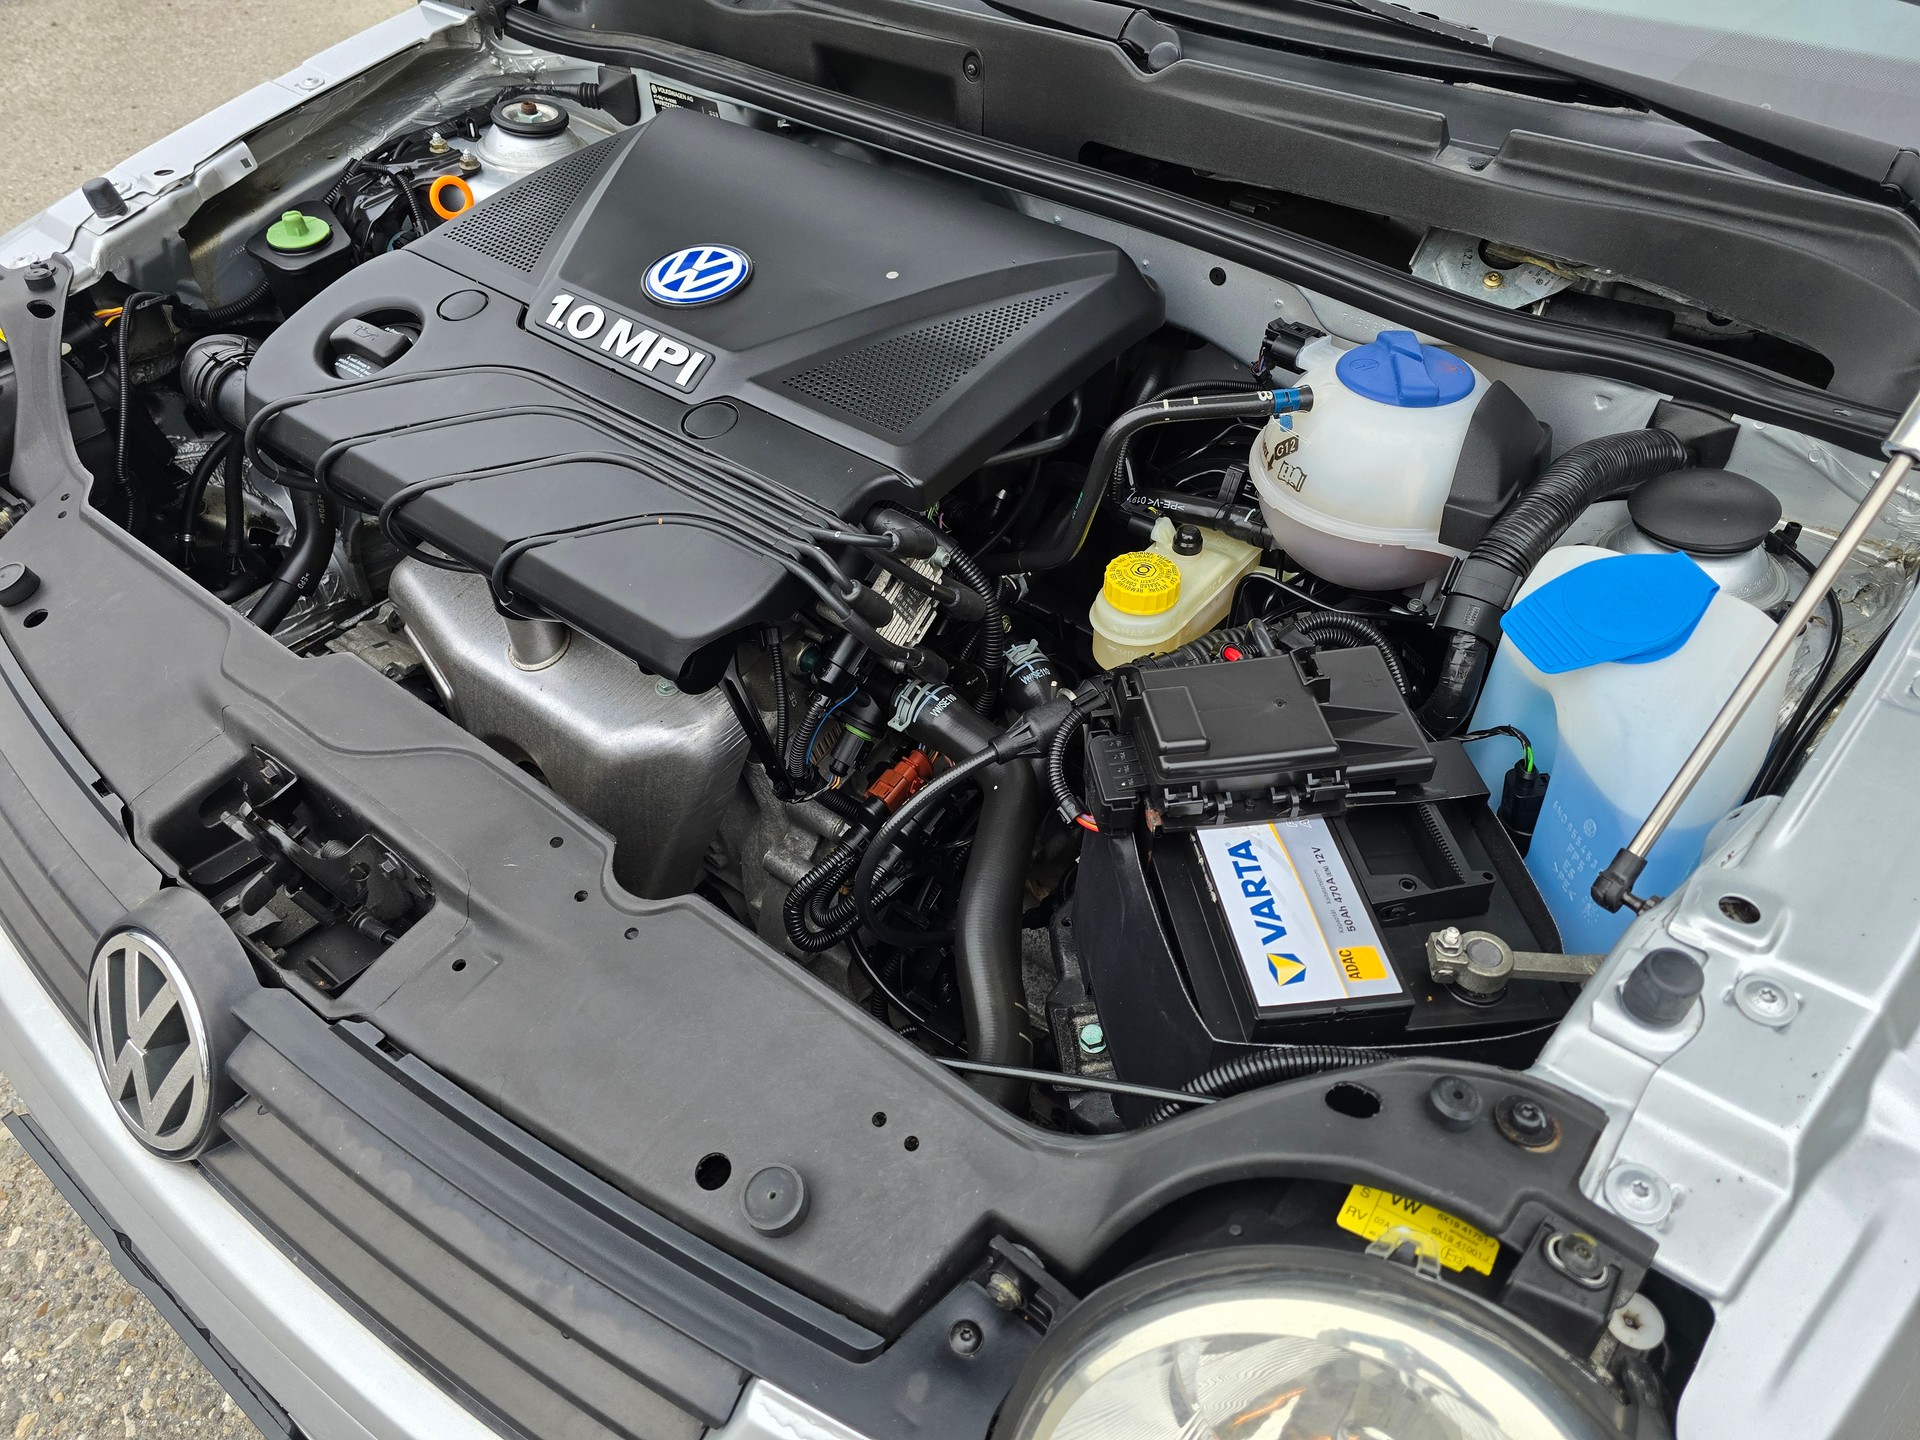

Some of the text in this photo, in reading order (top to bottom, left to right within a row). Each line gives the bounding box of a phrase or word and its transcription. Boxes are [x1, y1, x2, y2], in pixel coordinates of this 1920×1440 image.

[545, 294, 706, 387] 1.0 MPI
[1276, 439, 1296, 457] G12
[1310, 846, 1326, 865] 12V
[1227, 839, 1288, 946] VARTA
[1338, 949, 1363, 980] ADAC
[1359, 1187, 1372, 1199] S
[1345, 1205, 1369, 1221] RV
[1391, 1193, 1424, 1215] VW
